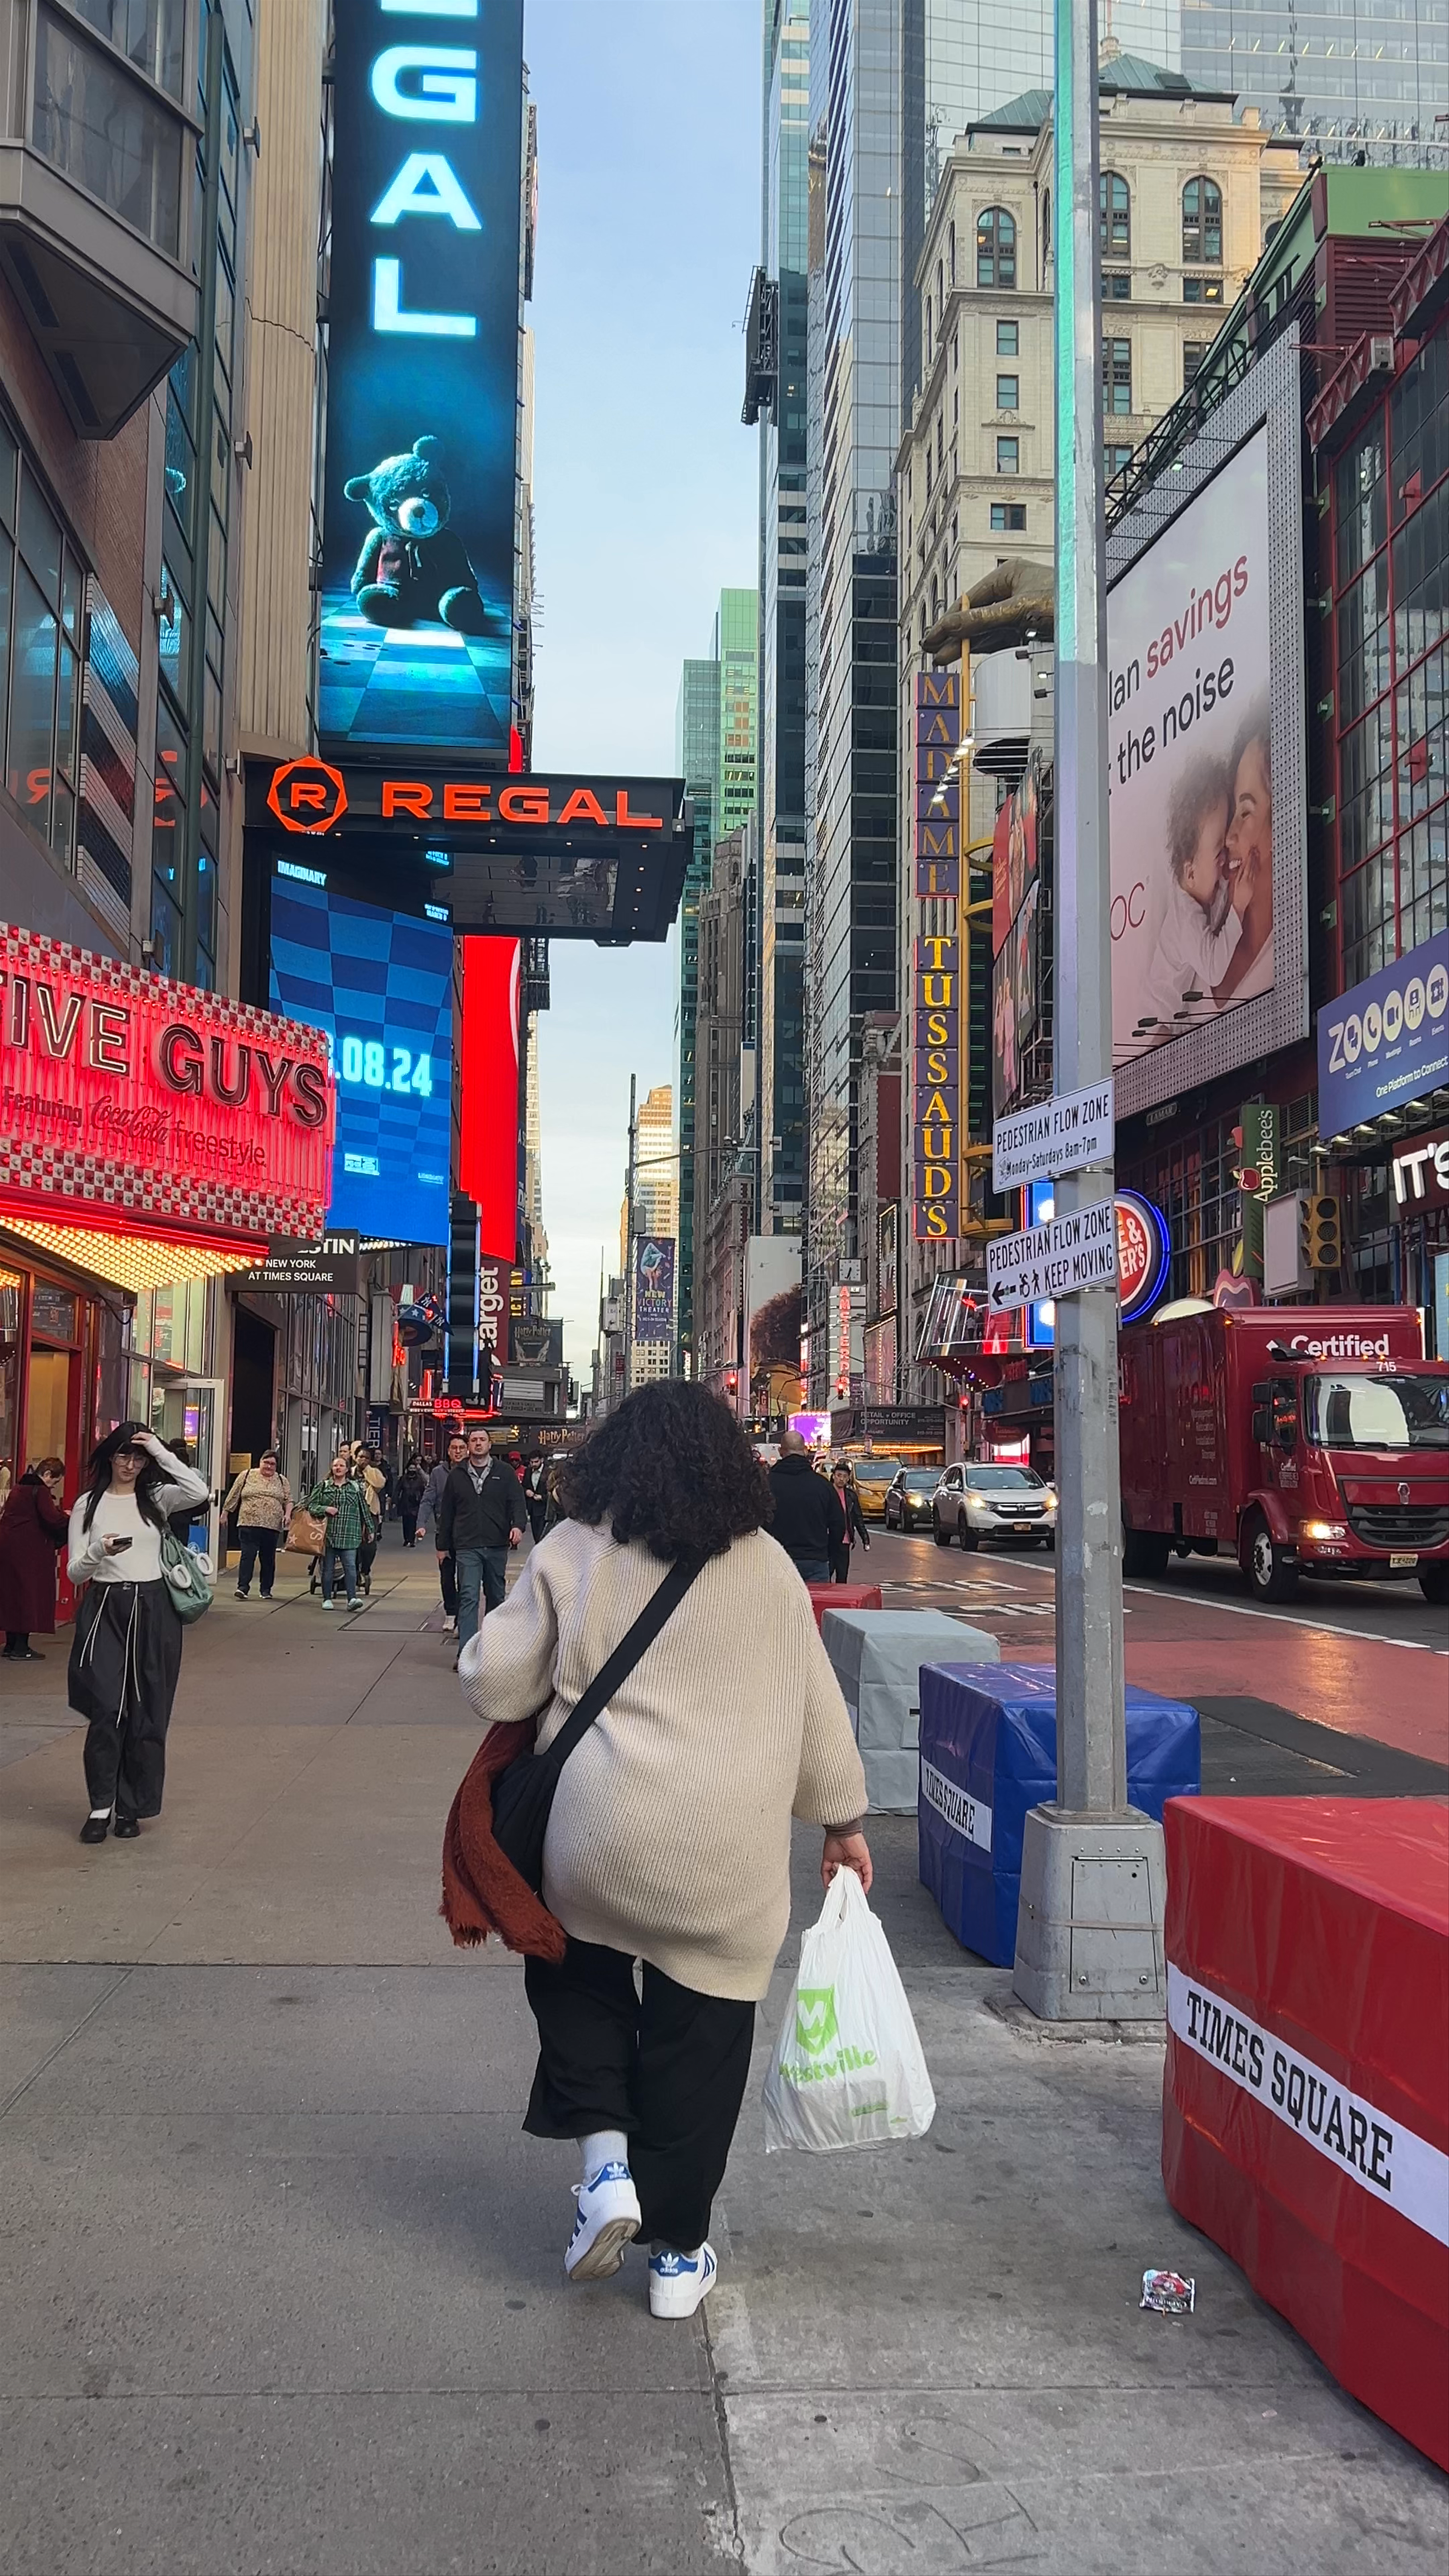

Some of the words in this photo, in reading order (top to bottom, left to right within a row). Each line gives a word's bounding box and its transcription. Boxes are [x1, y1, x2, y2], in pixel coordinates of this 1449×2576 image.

[370, 0, 482, 336] GAL
[1109, 658, 1139, 717] lan
[1147, 555, 1248, 678] savings
[1117, 725, 1155, 784] the
[1163, 658, 1234, 748] noise
[291, 783, 327, 810] R
[382, 781, 663, 828] REGAL
[922, 675, 955, 893] MADAME
[277, 859, 328, 886] IMAGINARY
[0, 971, 130, 1077] IVE
[158, 1023, 328, 1128] GUYS
[327, 1032, 433, 1097] .08.24
[922, 937, 953, 1237] TUSSAUD'S
[1375, 1084, 1388, 1098] One
[1388, 1073, 1413, 1092] Platform
[1414, 1069, 1421, 1080] to
[3, 1085, 82, 1127] Featuring
[997, 1116, 1050, 1155] PEDESTRIAN
[1054, 1102, 1079, 1132] FLOW
[1082, 1094, 1109, 1124] ZONE
[1065, 1137, 1097, 1157] 8am-7pm
[1253, 1109, 1278, 1203] Applebee's
[990, 1228, 1050, 1273] PEDESTRIAN
[1054, 1217, 1081, 1252] FLOW
[1084, 1206, 1112, 1240] ZONE
[1126, 1217, 1143, 1244] &
[248, 1271, 261, 1281] AT
[263, 1272, 292, 1281] TIMES
[294, 1272, 334, 1282] SQUARE
[265, 1259, 288, 1268] NEW
[289, 1260, 316, 1269] YORK
[1044, 1259, 1070, 1291] KEEP
[1073, 1243, 1113, 1282] MOVING
[1118, 1243, 1146, 1280] ER'S
[637, 1298, 672, 1307] VICTORY
[1291, 1333, 1390, 1356] Certified
[1376, 1361, 1397, 1372] 715
[434, 1398, 463, 1408] BBQ
[538, 1430, 561, 1445] Harry
[561, 1429, 585, 1443] Potter
[1187, 1990, 1265, 2088] TIMES
[1271, 2050, 1393, 2192] SQUARE
